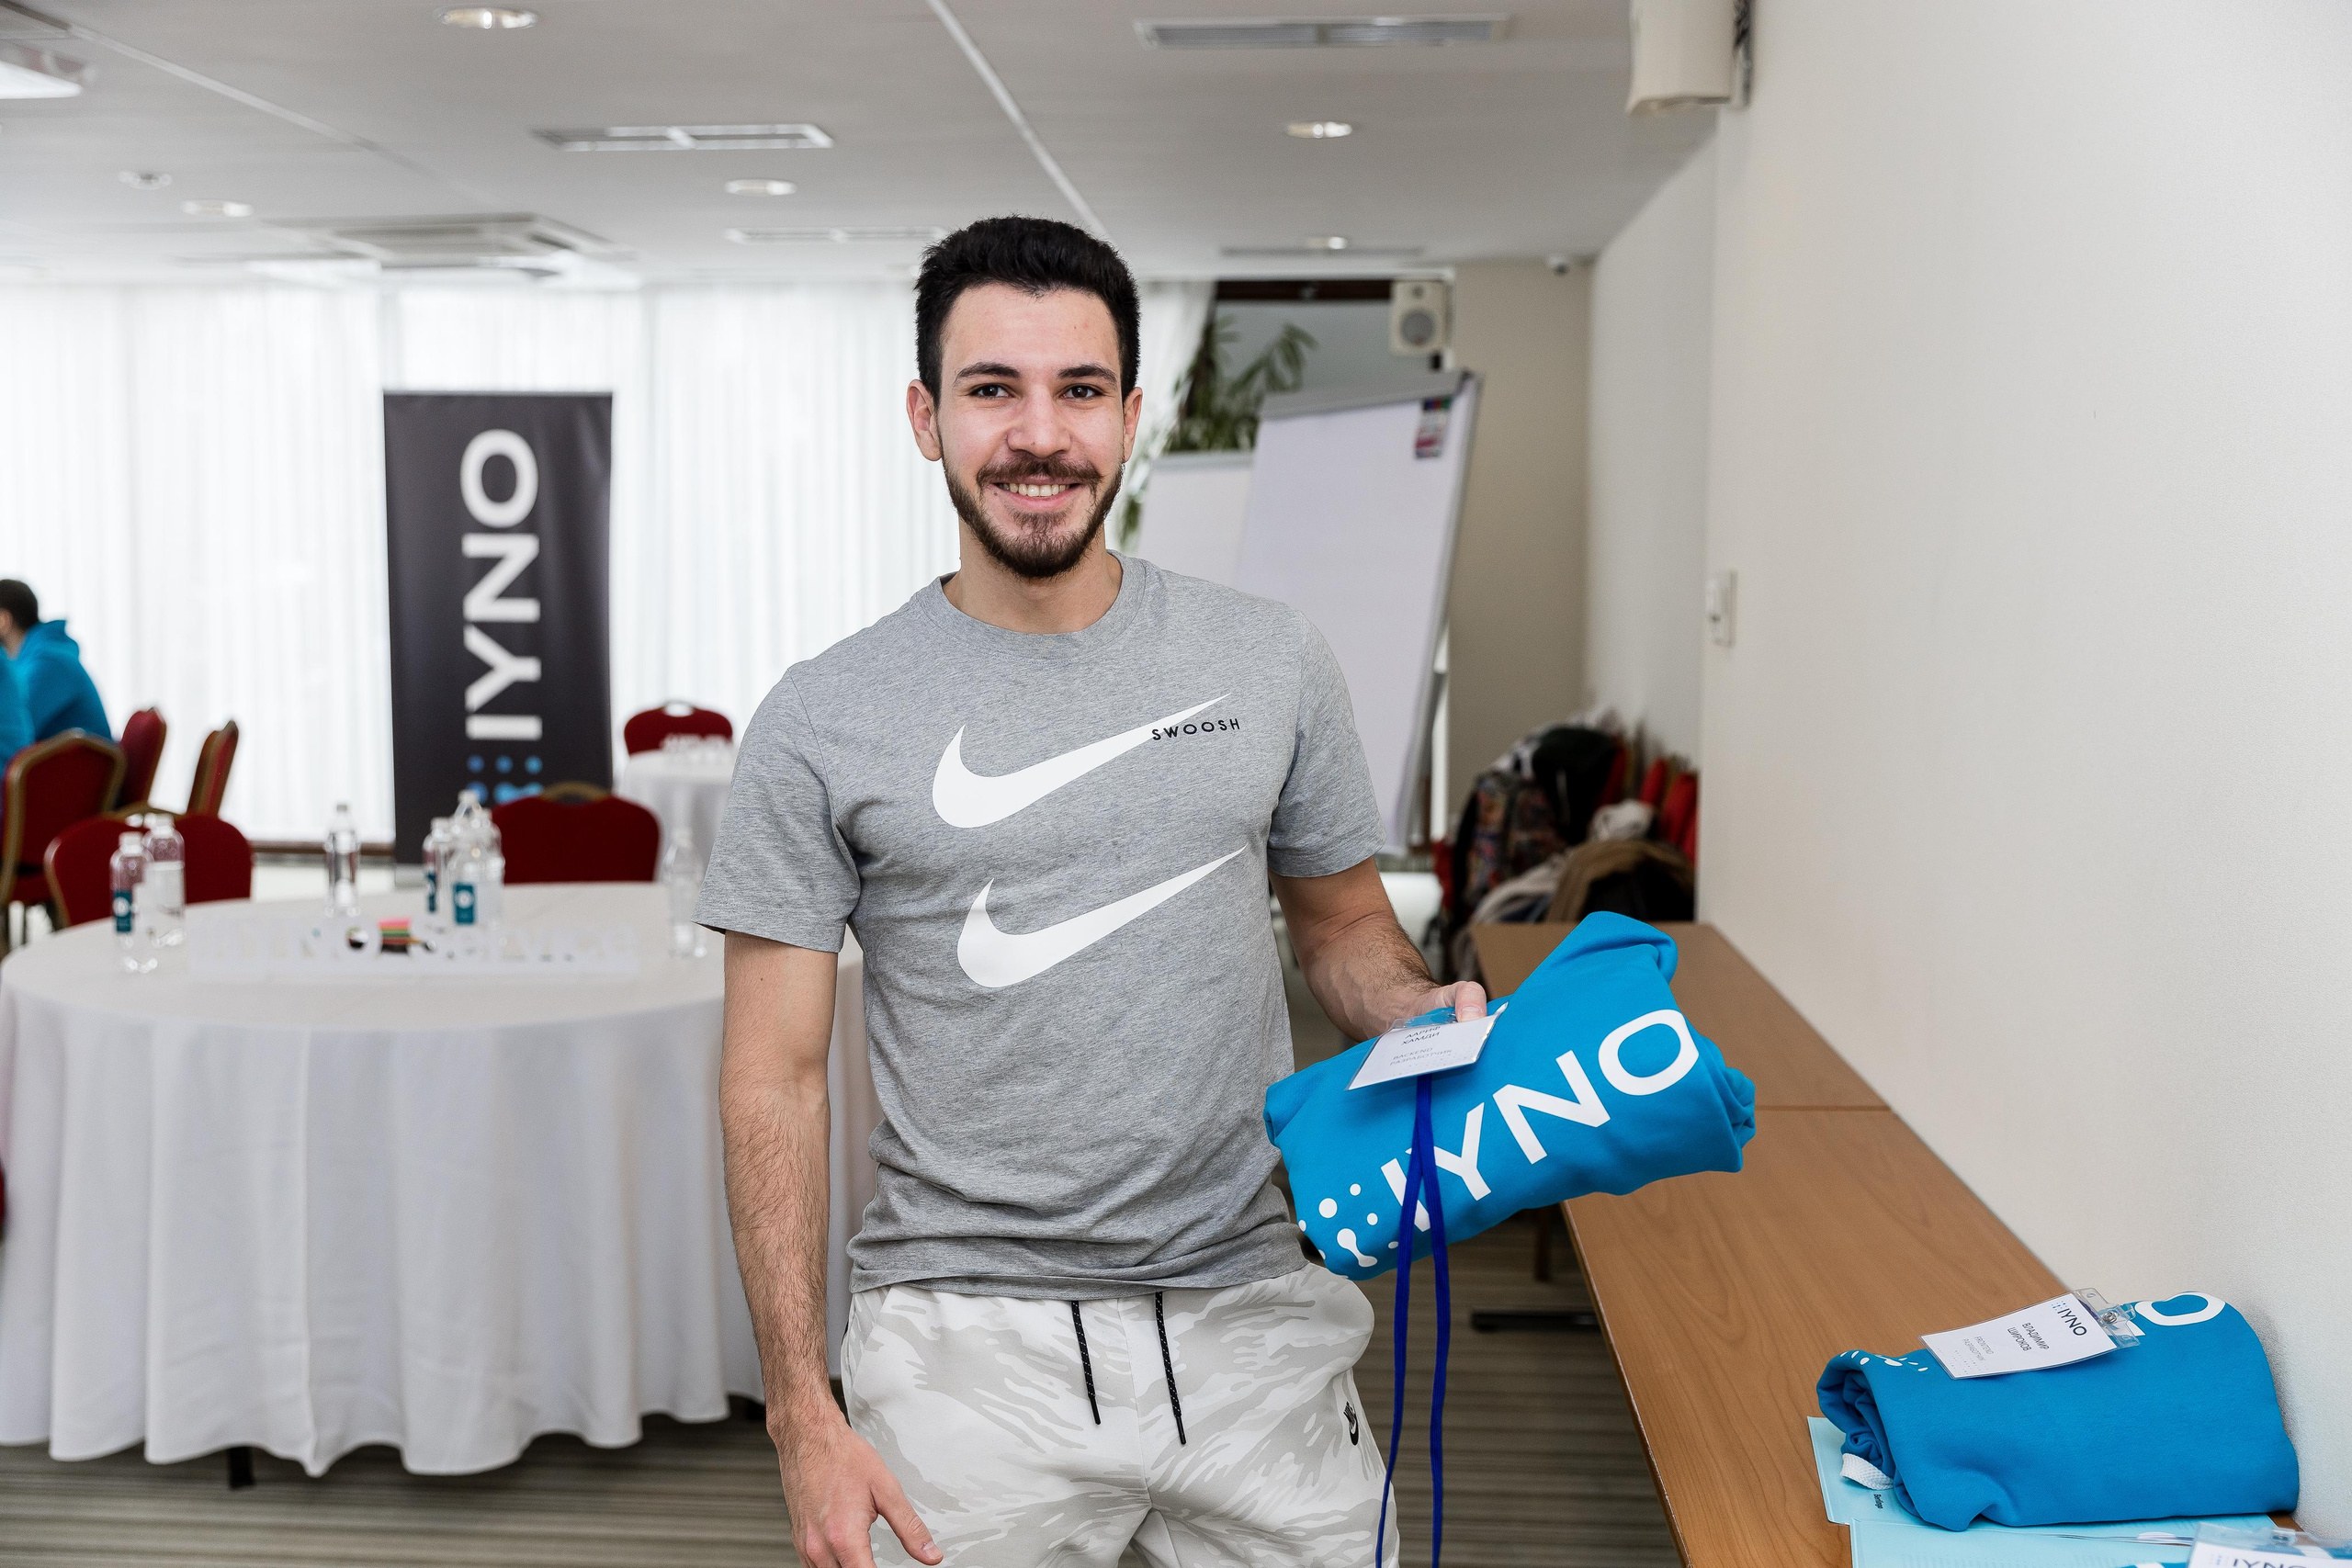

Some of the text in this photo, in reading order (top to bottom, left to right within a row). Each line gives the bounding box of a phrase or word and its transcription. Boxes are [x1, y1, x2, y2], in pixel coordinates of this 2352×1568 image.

[460, 429, 542, 739] IYNO
[1152, 718, 1240, 740] SWOOSH
[1401, 1032, 1440, 1045] ХАМДИ
[1389, 1049, 1452, 1066] РАЗРАБОТЧИК
[1393, 1048, 1432, 1060] BACKEND
[1380, 1009, 1700, 1233] IYNO
[2057, 1308, 2087, 1336] IYNO
[1974, 1337, 1994, 1355] FRONTEND
[2007, 1327, 2032, 1351] ШИРОКОВ
[2021, 1323, 2049, 1350] ВЛАДИМИР
